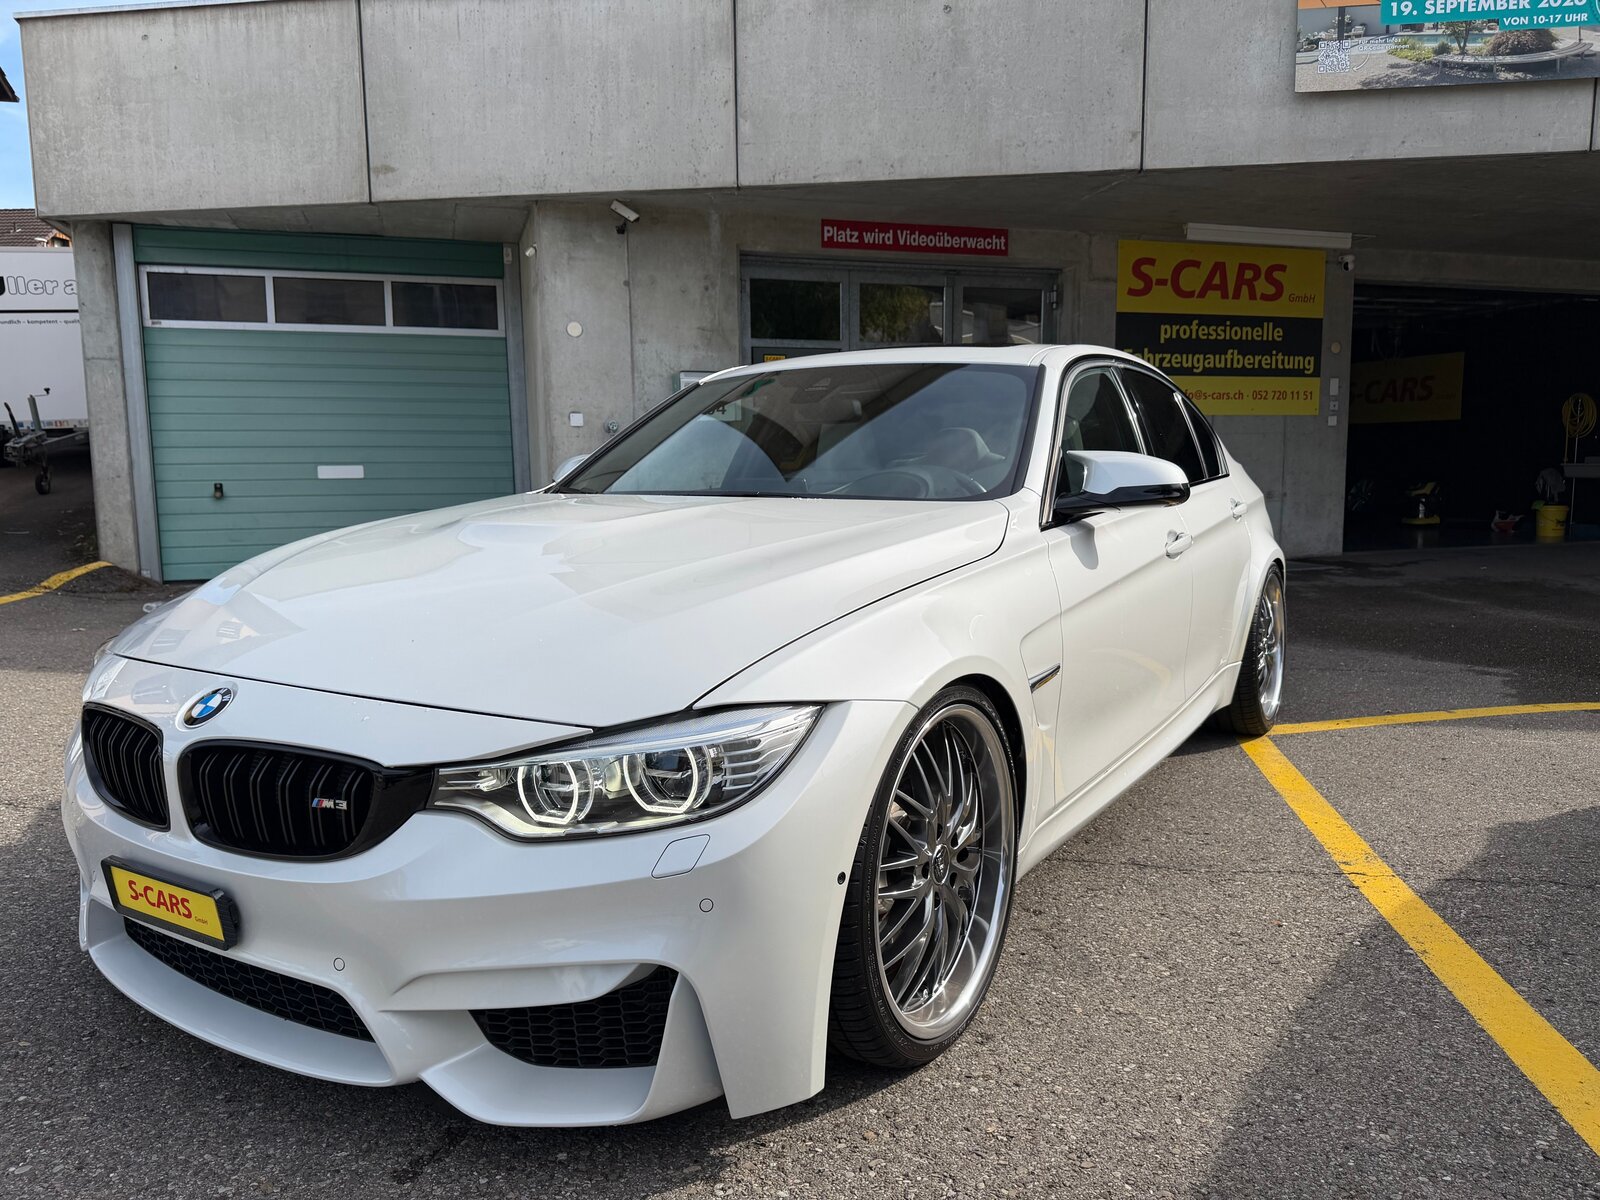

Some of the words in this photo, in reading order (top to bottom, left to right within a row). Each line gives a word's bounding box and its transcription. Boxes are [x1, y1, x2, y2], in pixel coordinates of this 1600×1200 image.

[1391, 2, 1418, 16] 19.
[1424, 0, 1531, 15] SEPTEMBER
[1503, 16, 1529, 26] VON
[1533, 14, 1562, 24] 10-17
[1565, 13, 1588, 23] UHR
[823, 226, 859, 243] Platz
[863, 229, 893, 245] wird
[897, 230, 1006, 250] Videoüberwacht
[1127, 257, 1288, 302] S-CARS
[1288, 293, 1316, 304] GmbH
[1160, 319, 1284, 344] professionelle
[1124, 347, 1315, 374] hrzeugaufbereitung
[1252, 390, 1268, 401] 052
[1271, 390, 1287, 401] 720
[1290, 390, 1300, 401] 11
[1303, 390, 1313, 401] 51
[318, 798, 347, 810] M3
[128, 879, 192, 919] S-CARS
